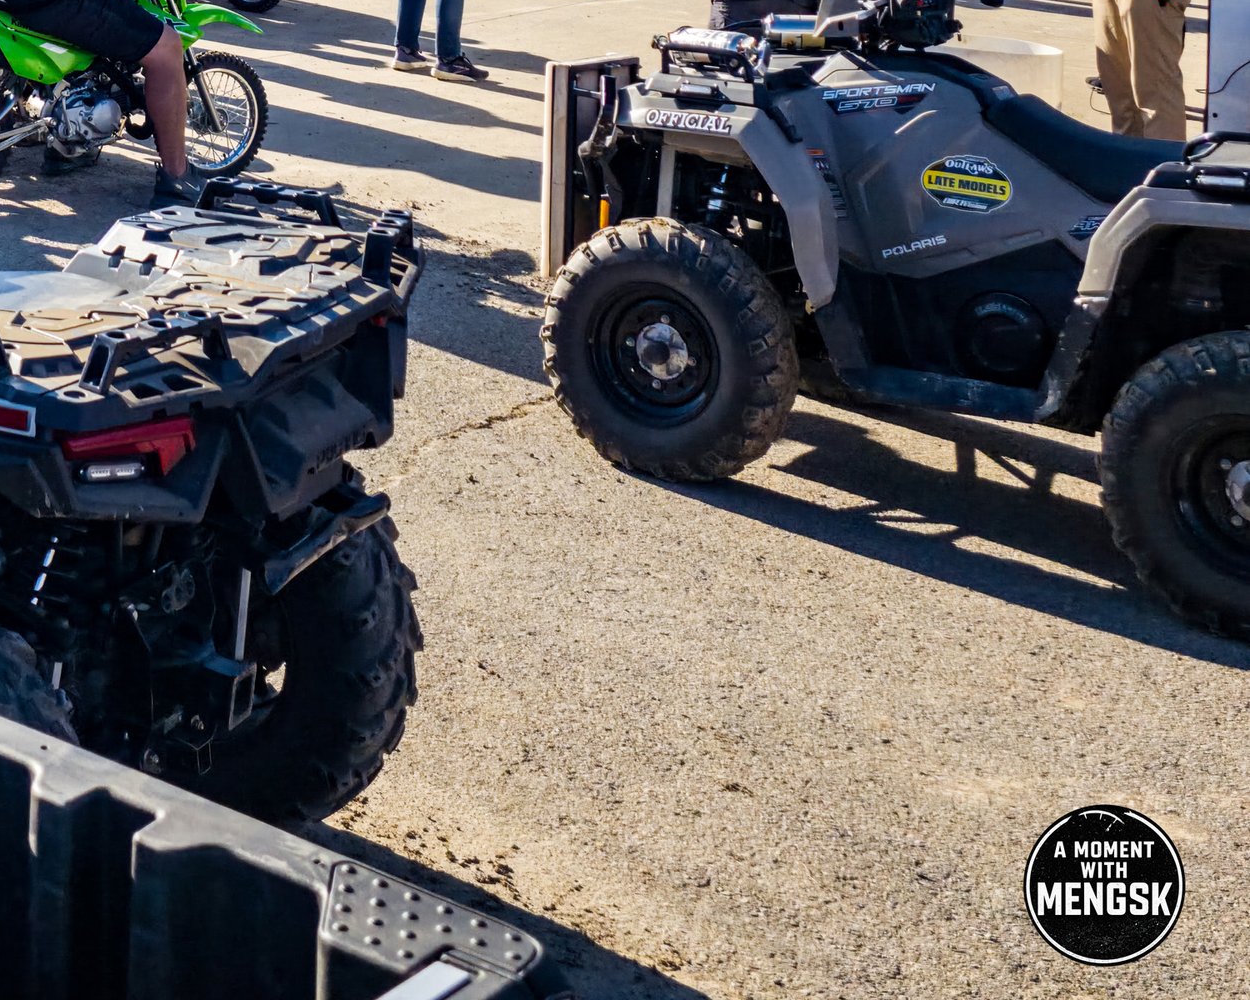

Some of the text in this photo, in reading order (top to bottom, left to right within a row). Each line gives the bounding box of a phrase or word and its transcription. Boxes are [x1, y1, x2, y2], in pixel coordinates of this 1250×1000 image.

[822, 82, 937, 101] SPORTSMAN
[646, 108, 732, 134] OFFICIAL
[928, 174, 1007, 196] LATE MODELS
[881, 234, 948, 260] POLARIS
